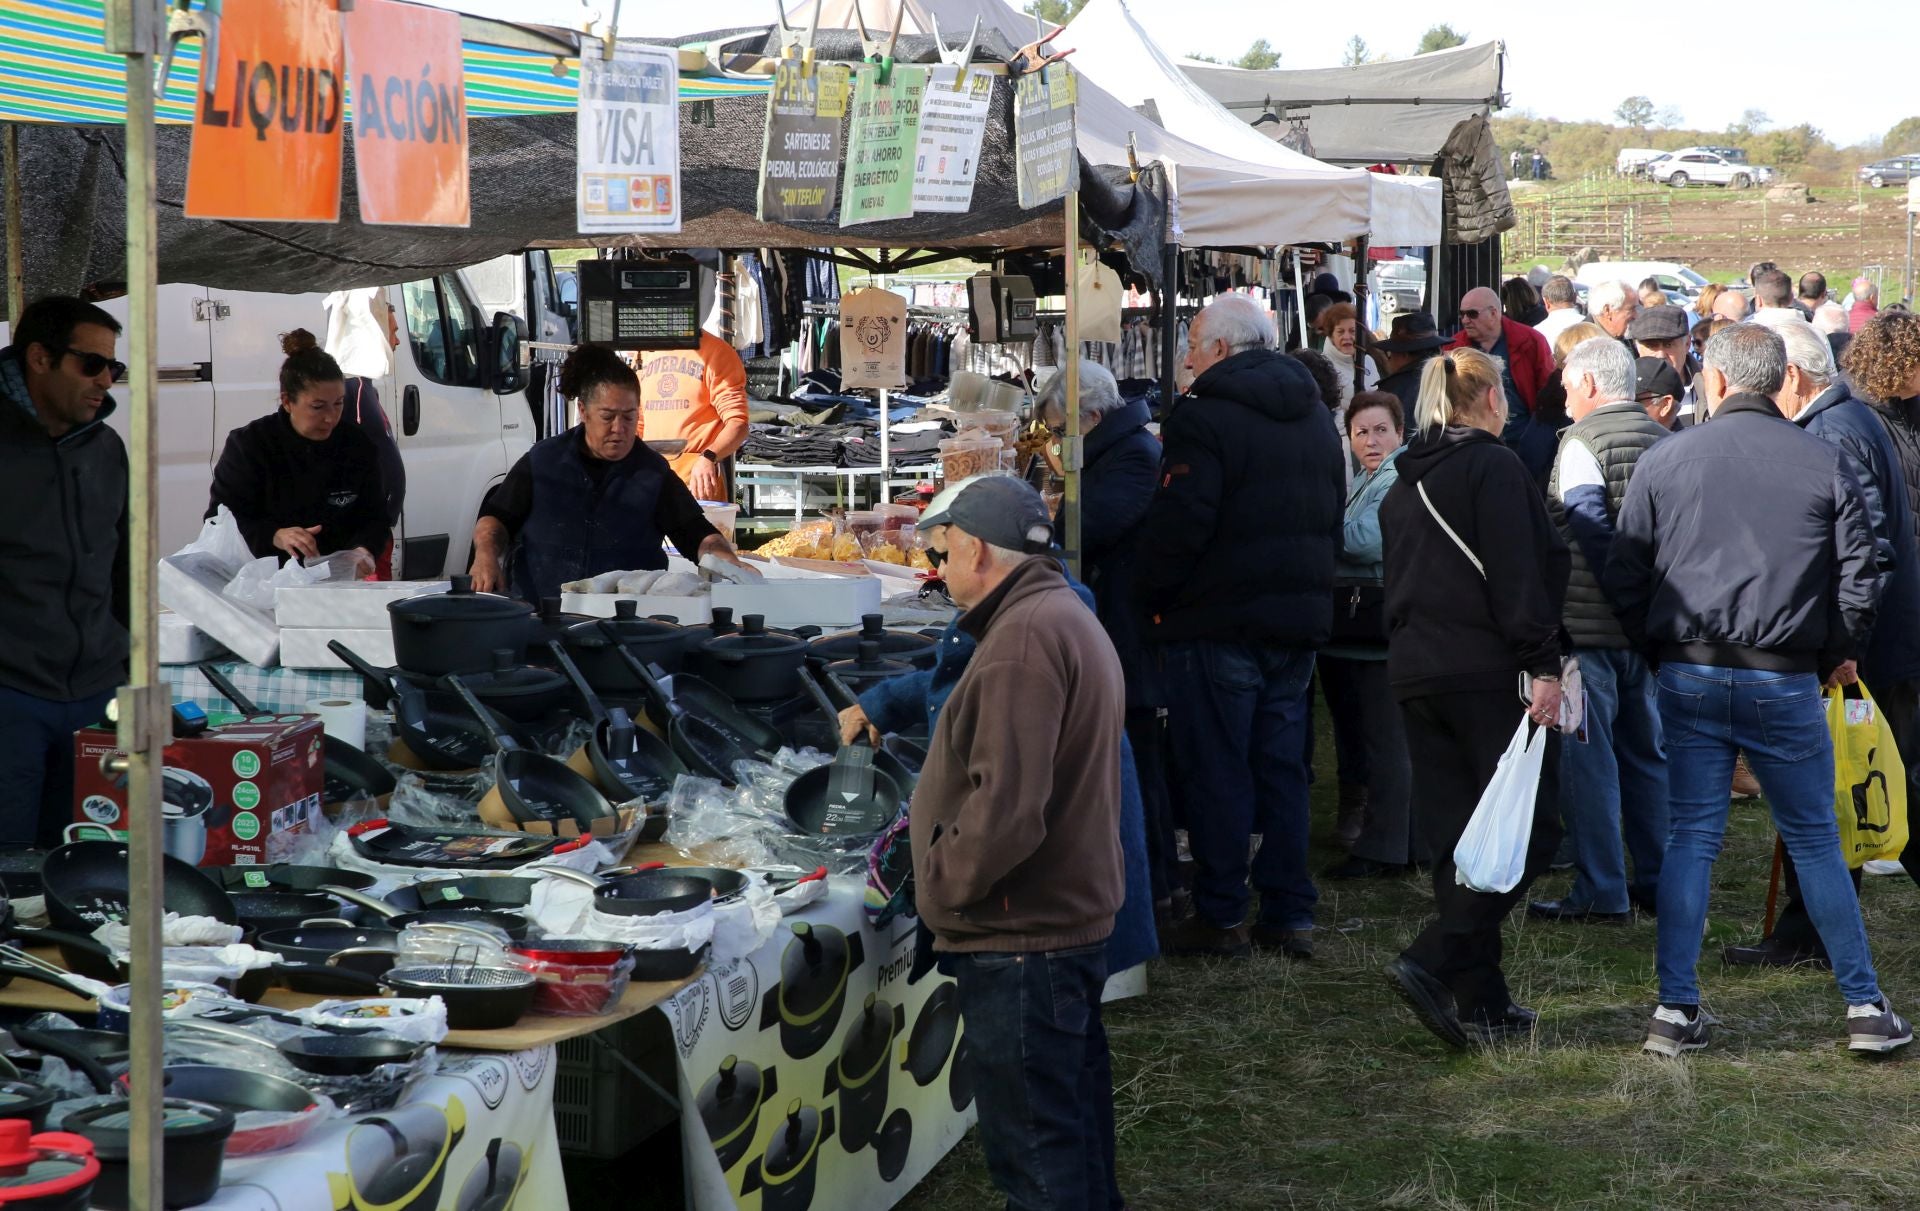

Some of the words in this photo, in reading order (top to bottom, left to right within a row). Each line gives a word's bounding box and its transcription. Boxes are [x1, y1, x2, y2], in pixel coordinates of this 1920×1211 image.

[906, 86, 920, 96] FREE
[203, 60, 340, 141] LIQUID
[358, 64, 461, 145] ACIÓN
[895, 99, 919, 115] PFOA
[904, 117, 917, 127] FREE
[594, 107, 655, 166] VISA
[784, 132, 820, 150] SARTENES
[821, 133, 832, 150] DE
[871, 146, 903, 163] AHORRO
[766, 160, 797, 179] PIEDRA,
[798, 158, 838, 178] ECOLÓGICAS
[854, 168, 899, 188] ENERGÉTICO
[861, 195, 885, 209] NUEVAS
[644, 399, 690, 411] AUTHENTIC
[237, 818, 255, 827] 2025
[877, 947, 914, 991] Premiu
